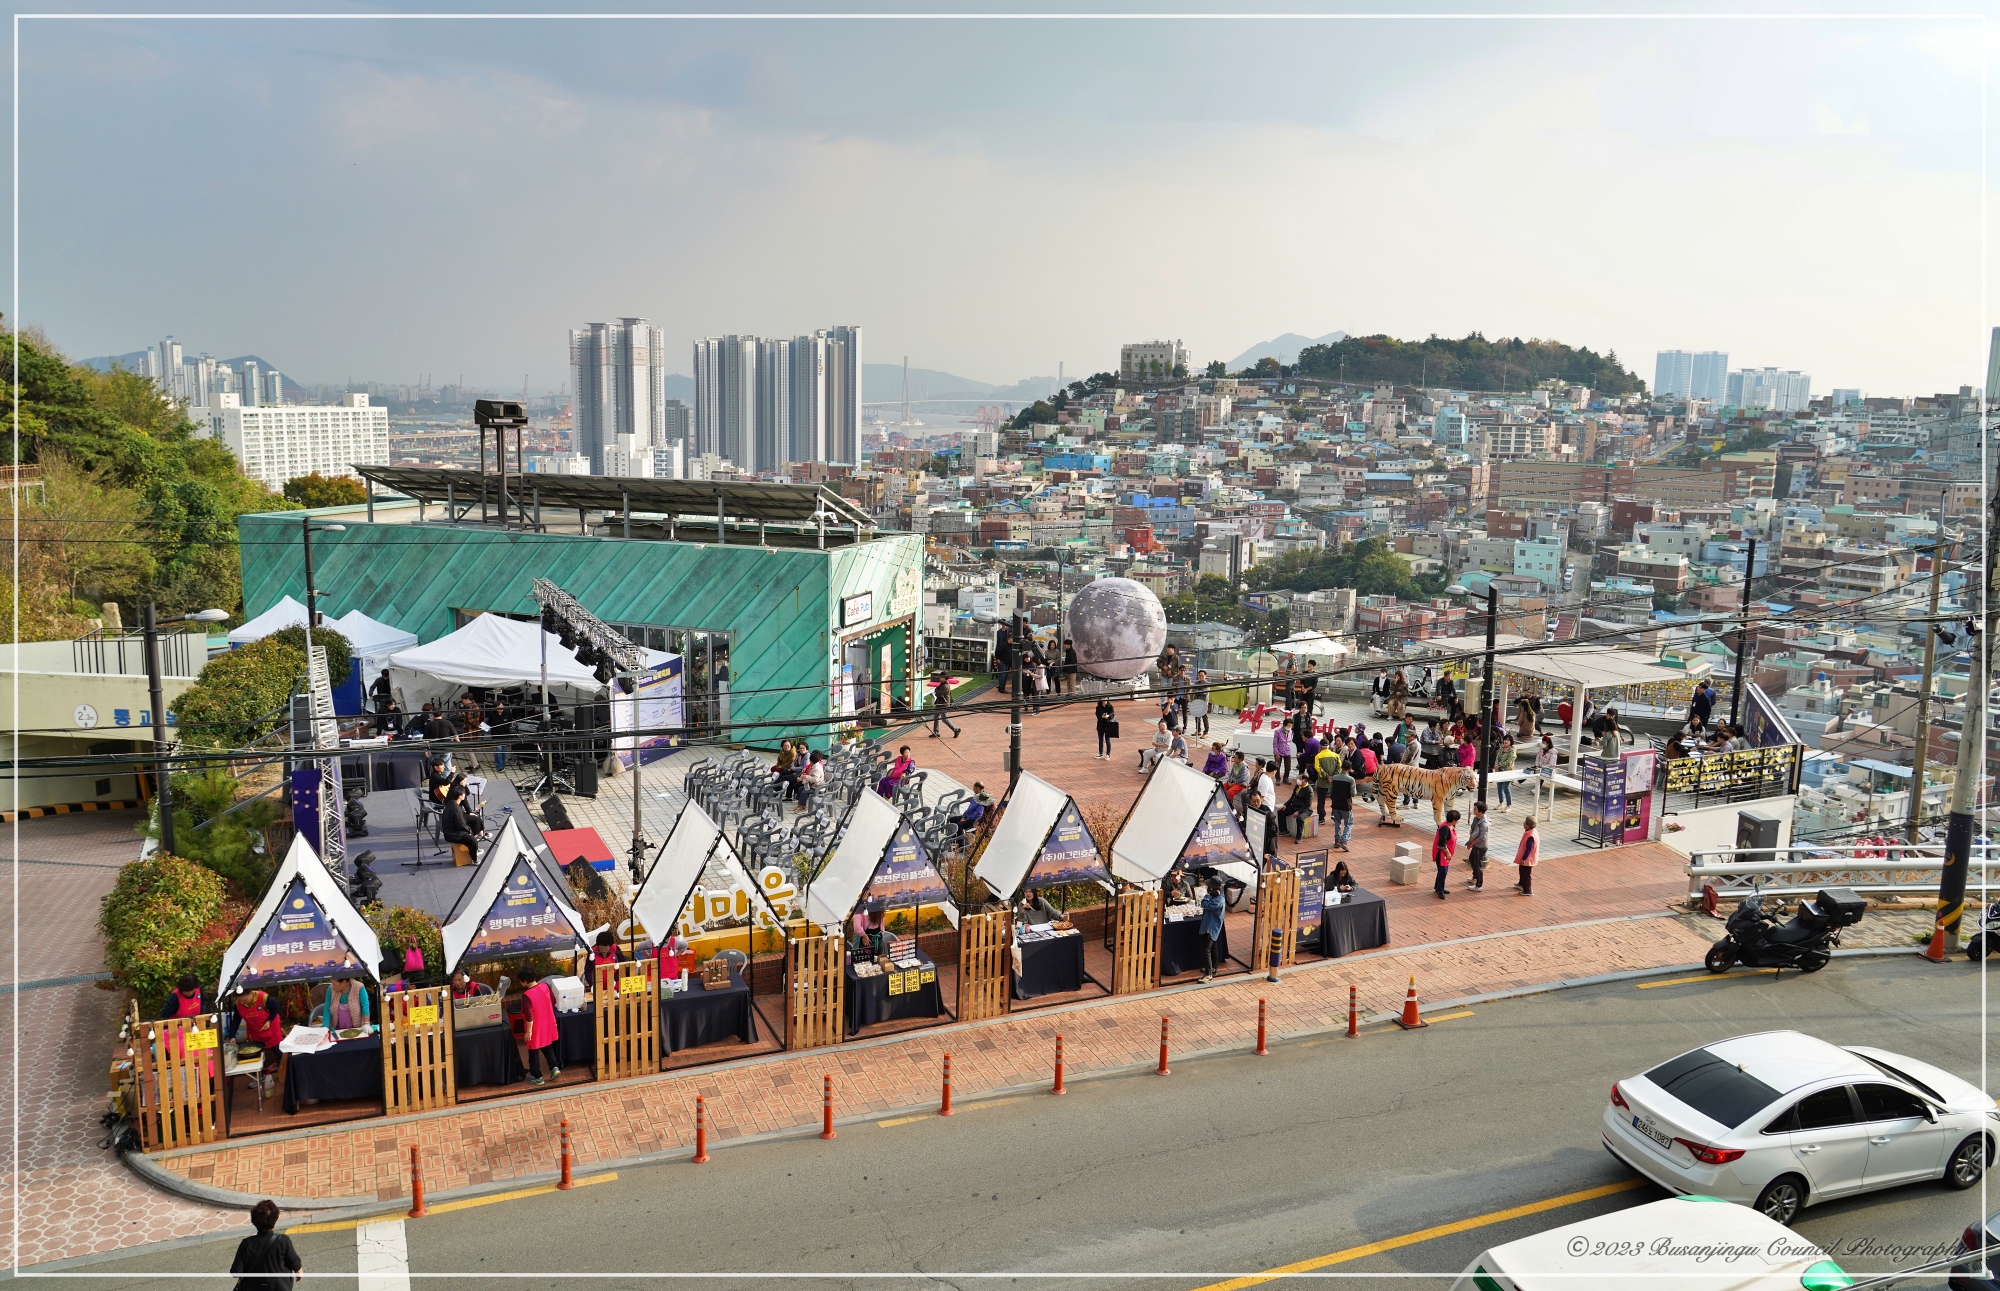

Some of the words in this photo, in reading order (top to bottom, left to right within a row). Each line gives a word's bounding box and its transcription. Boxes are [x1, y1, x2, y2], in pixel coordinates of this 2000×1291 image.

[861, 602, 869, 612] Pub
[77, 711, 94, 721] 2.3m
[874, 868, 935, 885] 호천문화플랫폼
[489, 916, 527, 930] 행복한
[531, 912, 556, 926] 동행
[261, 941, 304, 957] 행복한
[308, 938, 336, 952] 동행
[1654, 1131, 1670, 1145] 1087
